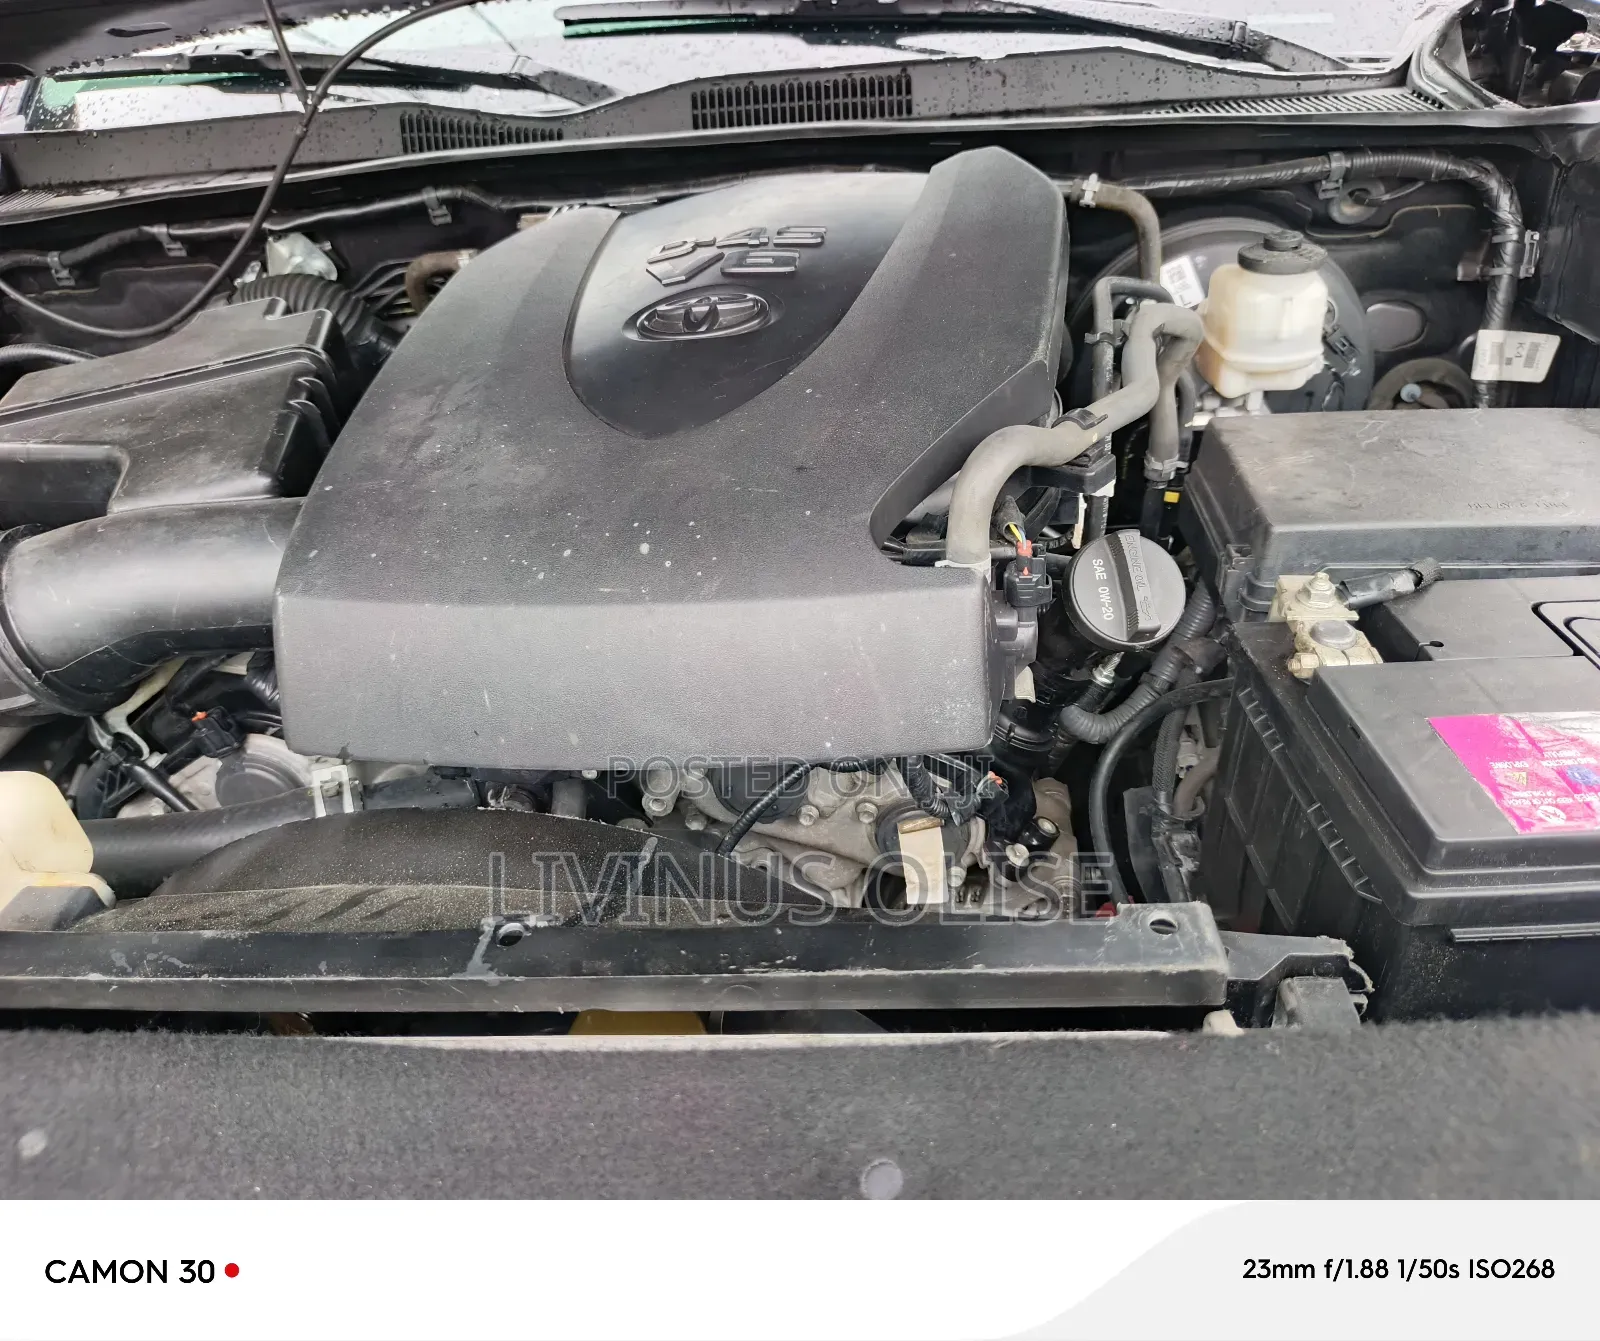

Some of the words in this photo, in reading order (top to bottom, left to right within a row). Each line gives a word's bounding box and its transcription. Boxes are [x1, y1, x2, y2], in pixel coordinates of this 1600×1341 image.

[646, 248, 800, 287] V6
[1092, 558, 1107, 580] SAE
[1097, 586, 1115, 621] 0W-20
